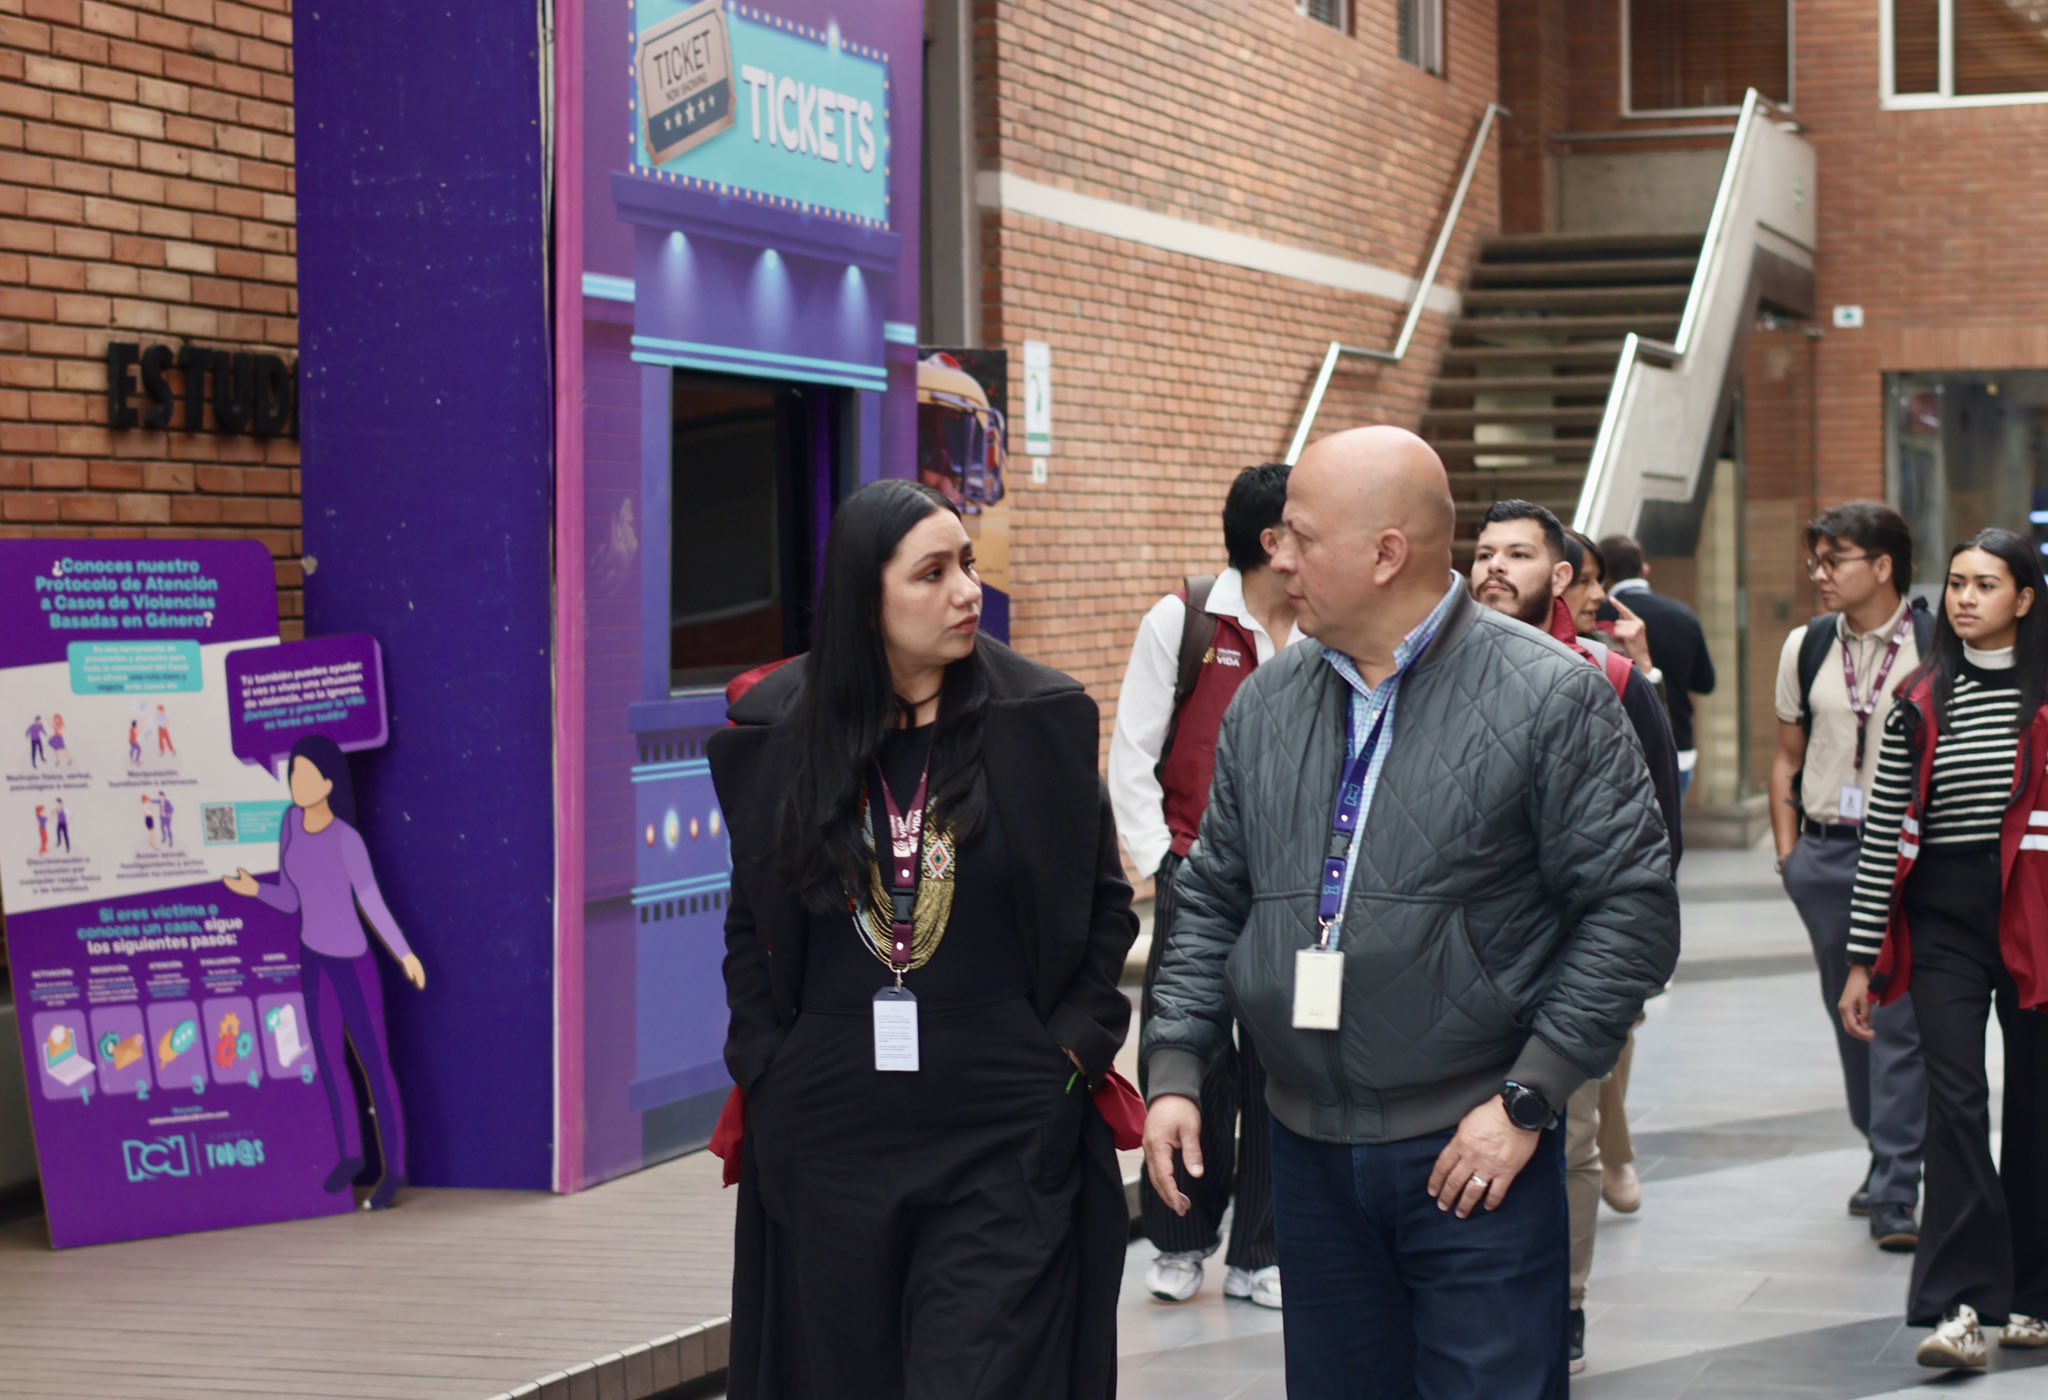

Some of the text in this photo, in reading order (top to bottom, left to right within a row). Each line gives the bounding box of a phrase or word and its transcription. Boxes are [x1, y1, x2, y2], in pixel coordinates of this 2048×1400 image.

[653, 30, 710, 88] TICKET
[741, 64, 876, 173] TICKETS
[52, 557, 200, 577] ¿Conoces nuestro
[35, 575, 218, 592] Protocolo de Atención
[41, 594, 216, 610] a Casos de Violencias
[50, 611, 214, 629] Basadas en Género?
[1216, 656, 1240, 668] VIDA
[912, 809, 922, 833] VIDA
[99, 907, 115, 923] Si
[116, 908, 149, 922] eres
[208, 904, 219, 917] o
[77, 925, 140, 940] conoces
[142, 923, 162, 936] un
[204, 916, 243, 933] sigue
[87, 933, 238, 956] los siguientes pasos:
[246, 1070, 260, 1088] 4
[300, 1064, 314, 1084] 5
[135, 1080, 149, 1100] 2
[191, 1074, 206, 1095] 3
[80, 1086, 90, 1105] 1
